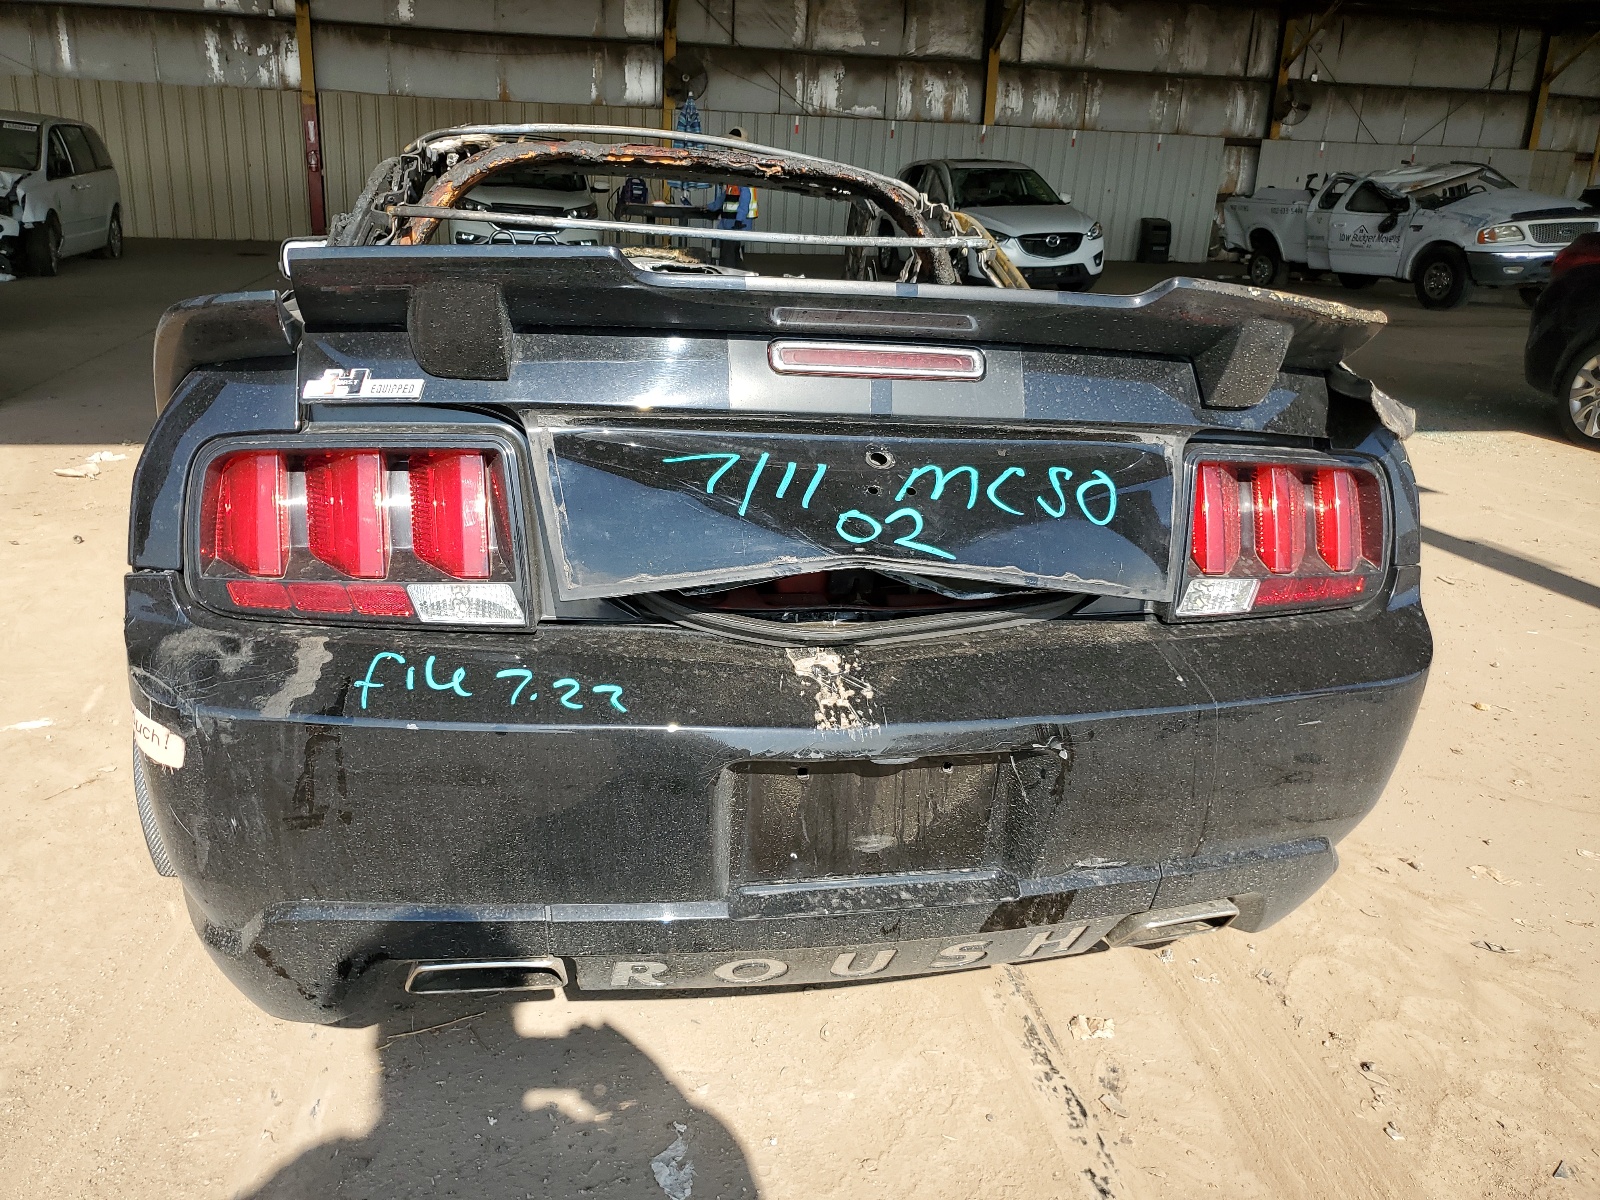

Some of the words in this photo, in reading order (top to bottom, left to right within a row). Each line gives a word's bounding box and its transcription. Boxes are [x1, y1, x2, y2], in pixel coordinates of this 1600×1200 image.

[370, 384, 415, 394] EQUIPPED
[663, 452, 828, 517] 7/11
[836, 507, 957, 560] 02
[611, 925, 1090, 987] ROUSH
